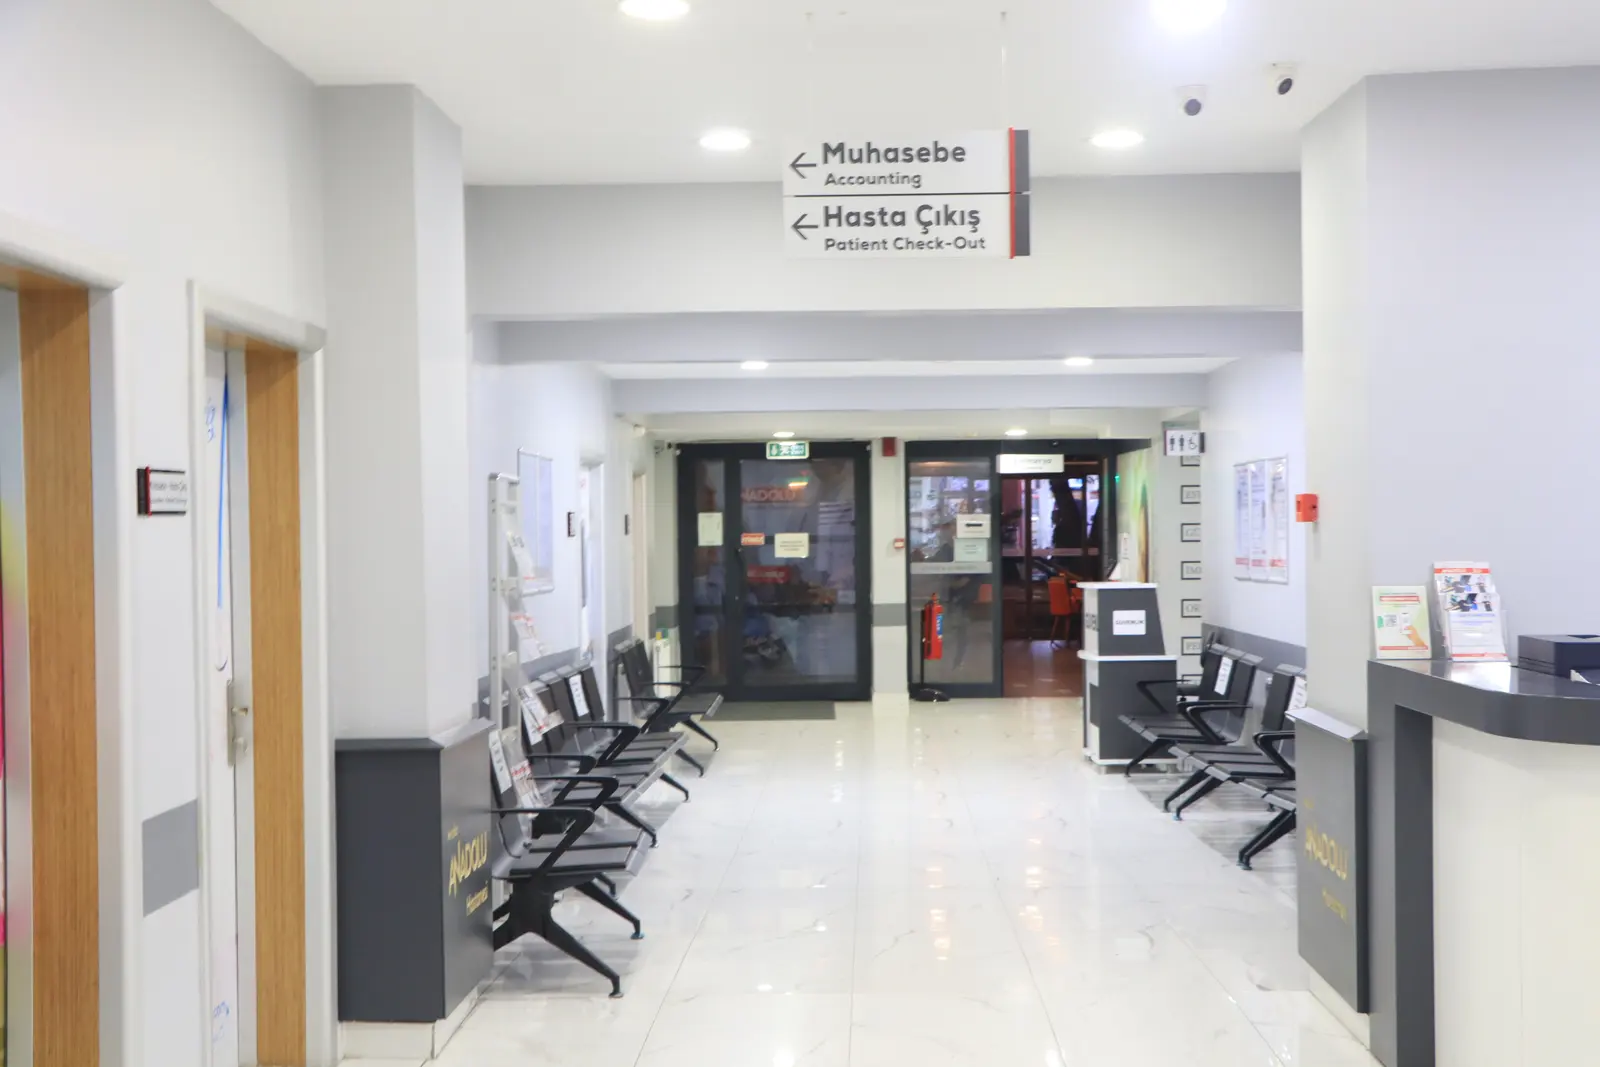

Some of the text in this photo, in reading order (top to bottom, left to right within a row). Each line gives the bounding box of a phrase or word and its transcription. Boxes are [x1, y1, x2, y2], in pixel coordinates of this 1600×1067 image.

[822, 140, 967, 165] Muhasebe
[824, 171, 923, 190] Accounting
[823, 203, 981, 236] Hasta Çıkış
[824, 235, 987, 252] Patient Check-Out
